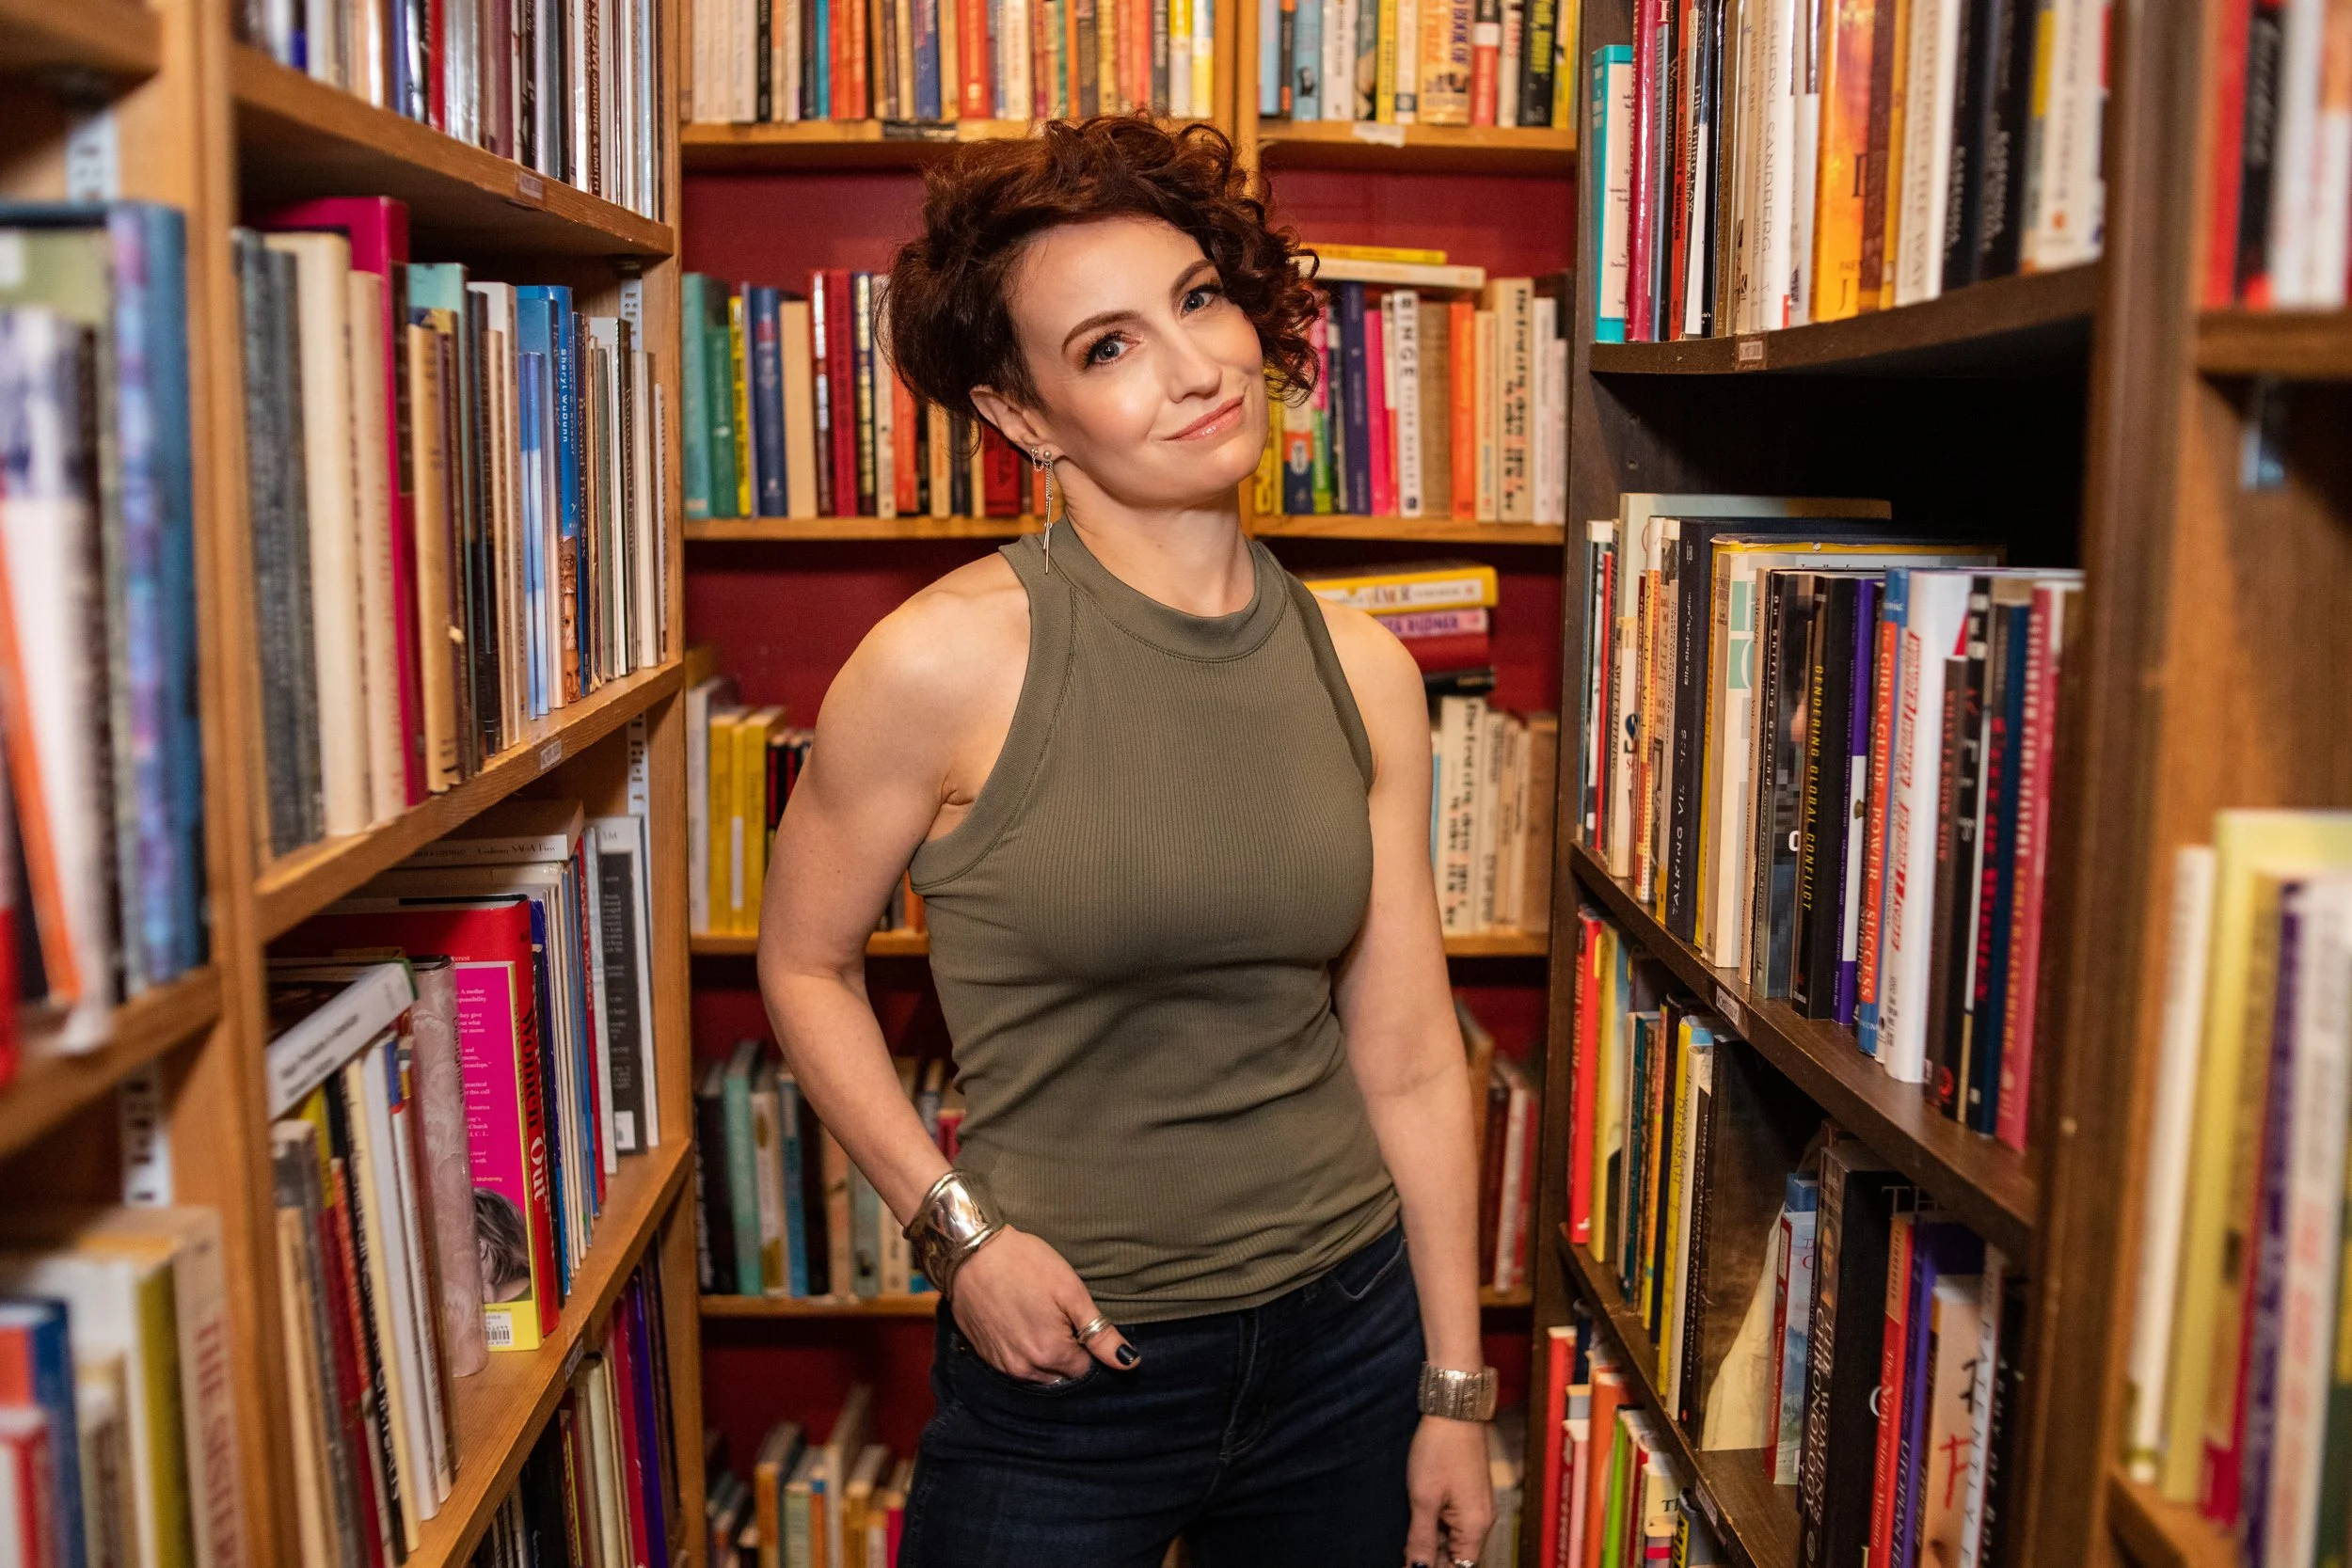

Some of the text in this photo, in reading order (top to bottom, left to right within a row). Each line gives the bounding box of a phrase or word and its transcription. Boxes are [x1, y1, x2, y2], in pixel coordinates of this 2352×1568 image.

[1665, 55, 1678, 167] Womanguides
[1677, 112, 1686, 177] AGAINST
[1761, 19, 1779, 253] SHERYL SANDBERG
[1691, 123, 1699, 174] THIRD
[560, 348, 570, 443] Sheryl WuDunn
[625, 386, 634, 454] Women
[1636, 594, 1645, 645] ophelia
[1753, 596, 1761, 645] SIGNS
[1773, 595, 1780, 616] On
[1769, 628, 1778, 708] Shifting
[1878, 653, 1893, 720] GIRLS'
[1610, 663, 1622, 769] SWEET SUFFERING
[1766, 721, 1774, 786] Ground
[1874, 722, 1889, 788] GUIDE
[1803, 665, 1824, 911] GENDERING GLOBAL CONFLICT
[1672, 825, 1683, 916] TALKING
[1868, 807, 1883, 881] POWER
[1867, 884, 1876, 908] and
[1861, 909, 1876, 998] SUCCESS
[453, 1017, 465, 1104] Daughters
[520, 1006, 547, 1202] Women Out
[1673, 1097, 1685, 1185] DEBORAH
[1700, 1113, 1708, 1166] WOMEN
[1695, 1195, 1704, 1253] MODERN
[1702, 1186, 1714, 1253] WISE
[1691, 1259, 1700, 1320] TURKISH
[1687, 1323, 1695, 1383] SOCIETY
[1804, 1307, 1825, 1516] CHRONOLOGY
[1813, 1318, 1835, 1525] THE WOMEN'S
[1879, 1381, 1895, 1427] New
[1988, 1358, 2009, 1488] ARMY OF
[1873, 1491, 1886, 1549] Woman
[1894, 1438, 1911, 1539] UTOPIAN
